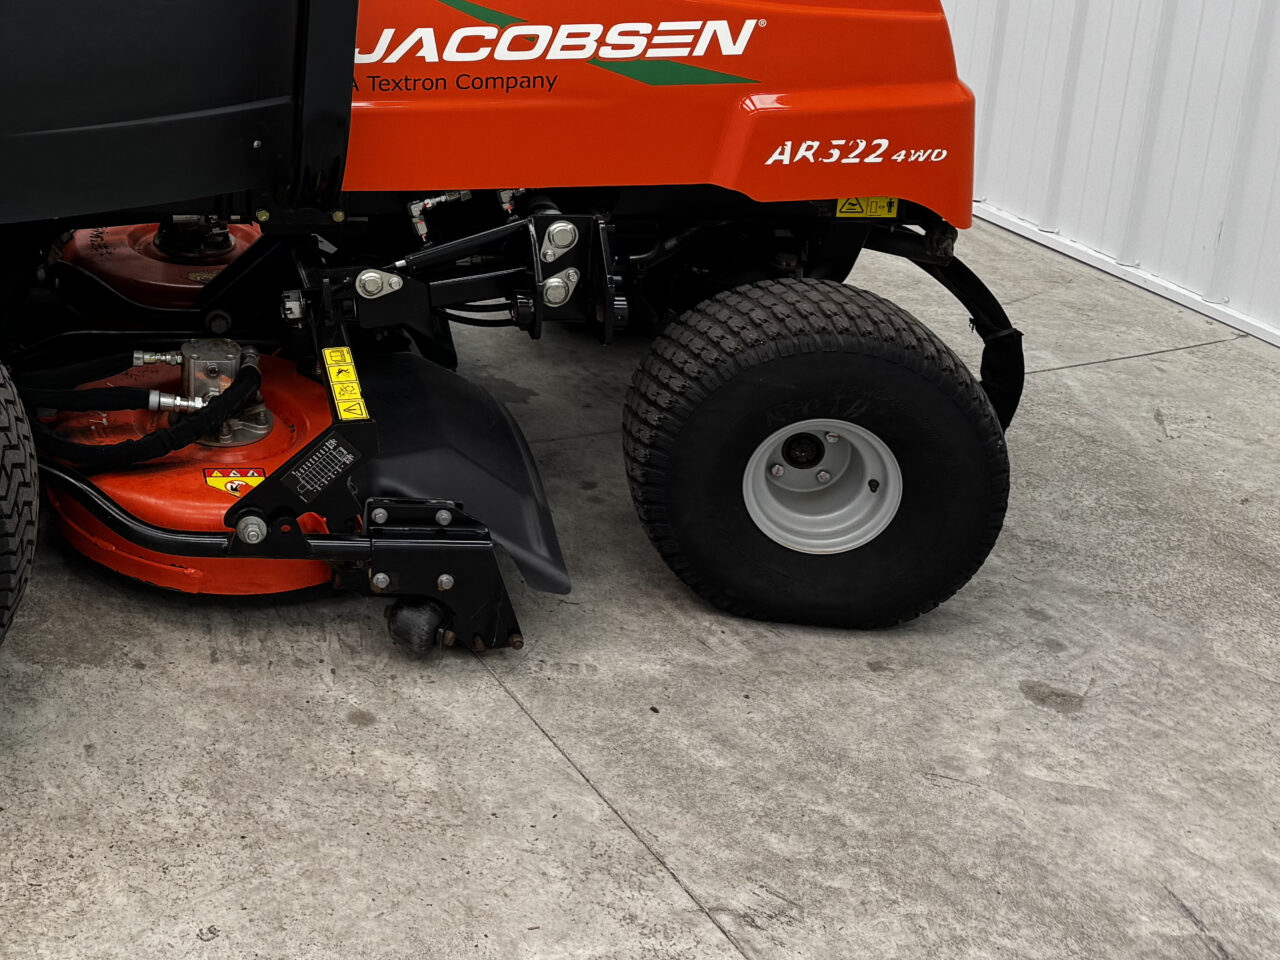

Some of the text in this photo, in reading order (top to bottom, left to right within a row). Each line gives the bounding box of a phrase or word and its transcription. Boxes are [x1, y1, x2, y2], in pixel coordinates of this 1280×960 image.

[367, 74, 447, 92] Textron
[455, 73, 558, 93] Company
[764, 138, 948, 165] AR522 4WD
